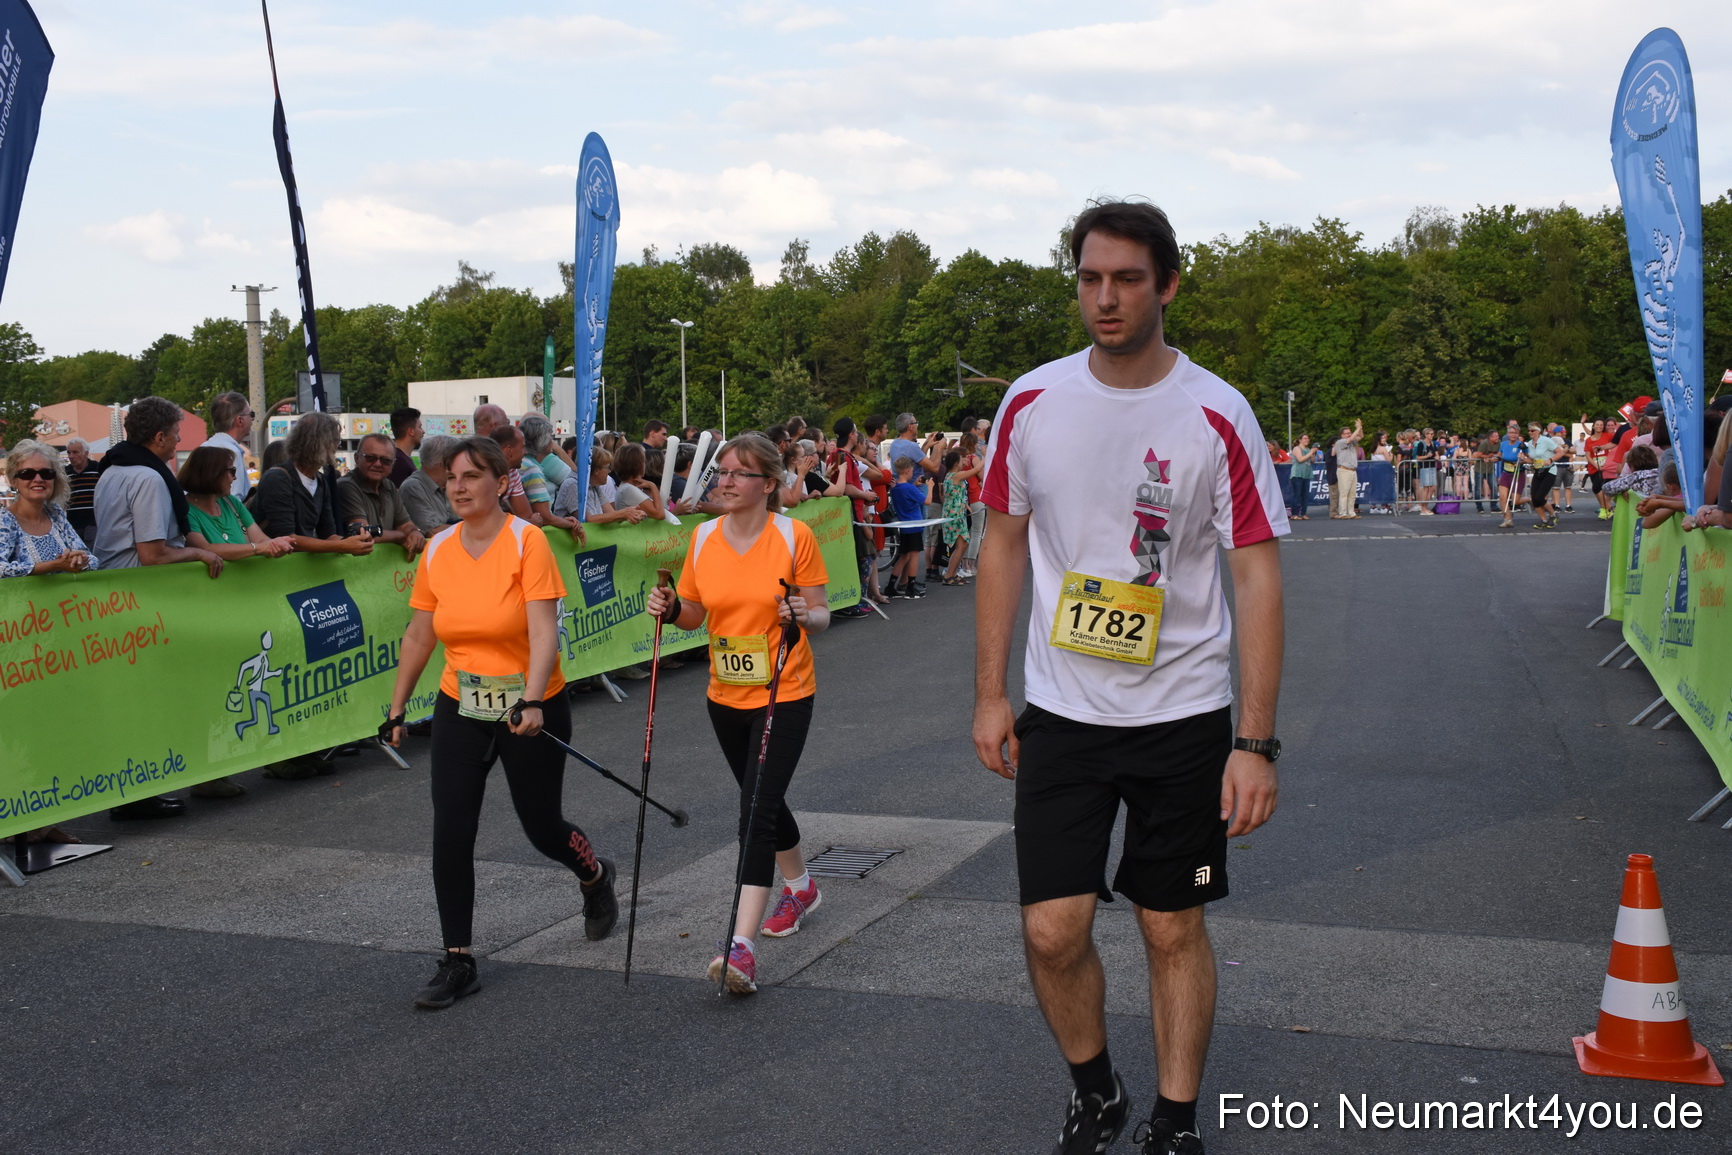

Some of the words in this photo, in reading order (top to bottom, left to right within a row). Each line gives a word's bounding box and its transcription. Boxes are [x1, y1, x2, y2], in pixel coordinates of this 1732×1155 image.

[1137, 483, 1173, 505] OM
[1309, 481, 1369, 493] Fiser
[583, 563, 609, 579] Fischer
[58, 591, 141, 628] Firmen
[309, 604, 348, 624] Fischer
[573, 580, 646, 640] firmenlauf
[318, 614, 349, 629] AUTOMOBILE
[1070, 602, 1146, 642] 1782
[0, 643, 78, 690] laufen
[82, 611, 170, 665] länger!
[578, 630, 613, 653] neumarkt
[1069, 630, 1098, 643] Krämer
[1100, 636, 1137, 650] Bernhard
[281, 634, 402, 707] firmenlau
[722, 654, 753, 671] 106
[287, 690, 349, 726] neumarkt
[472, 691, 506, 708] 111
